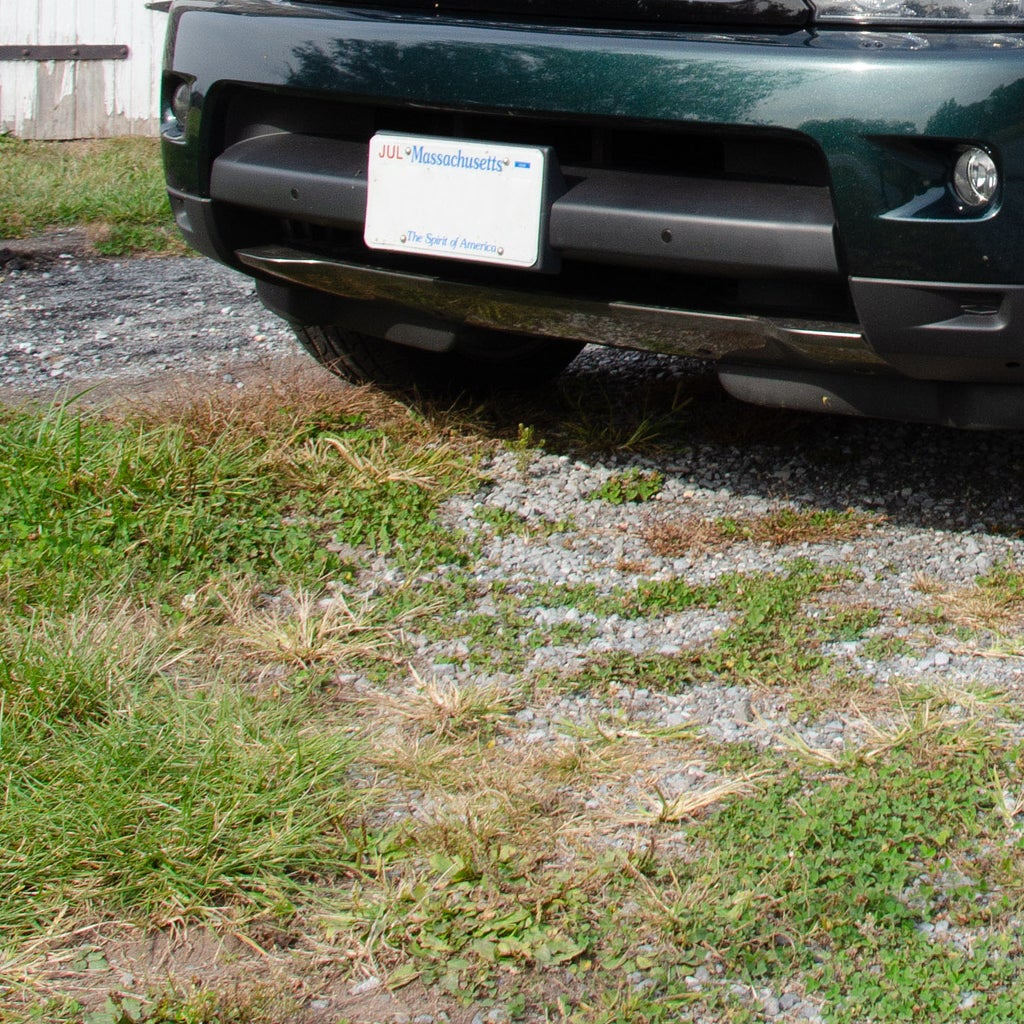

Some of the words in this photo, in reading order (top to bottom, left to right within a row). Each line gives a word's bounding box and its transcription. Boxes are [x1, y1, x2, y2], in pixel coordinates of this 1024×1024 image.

[378, 144, 403, 160] JUL
[411, 145, 503, 172] Massachusetts
[407, 230, 422, 243] The
[424, 233, 448, 246] Spirit
[450, 238, 459, 249] of
[460, 238, 497, 252] America
